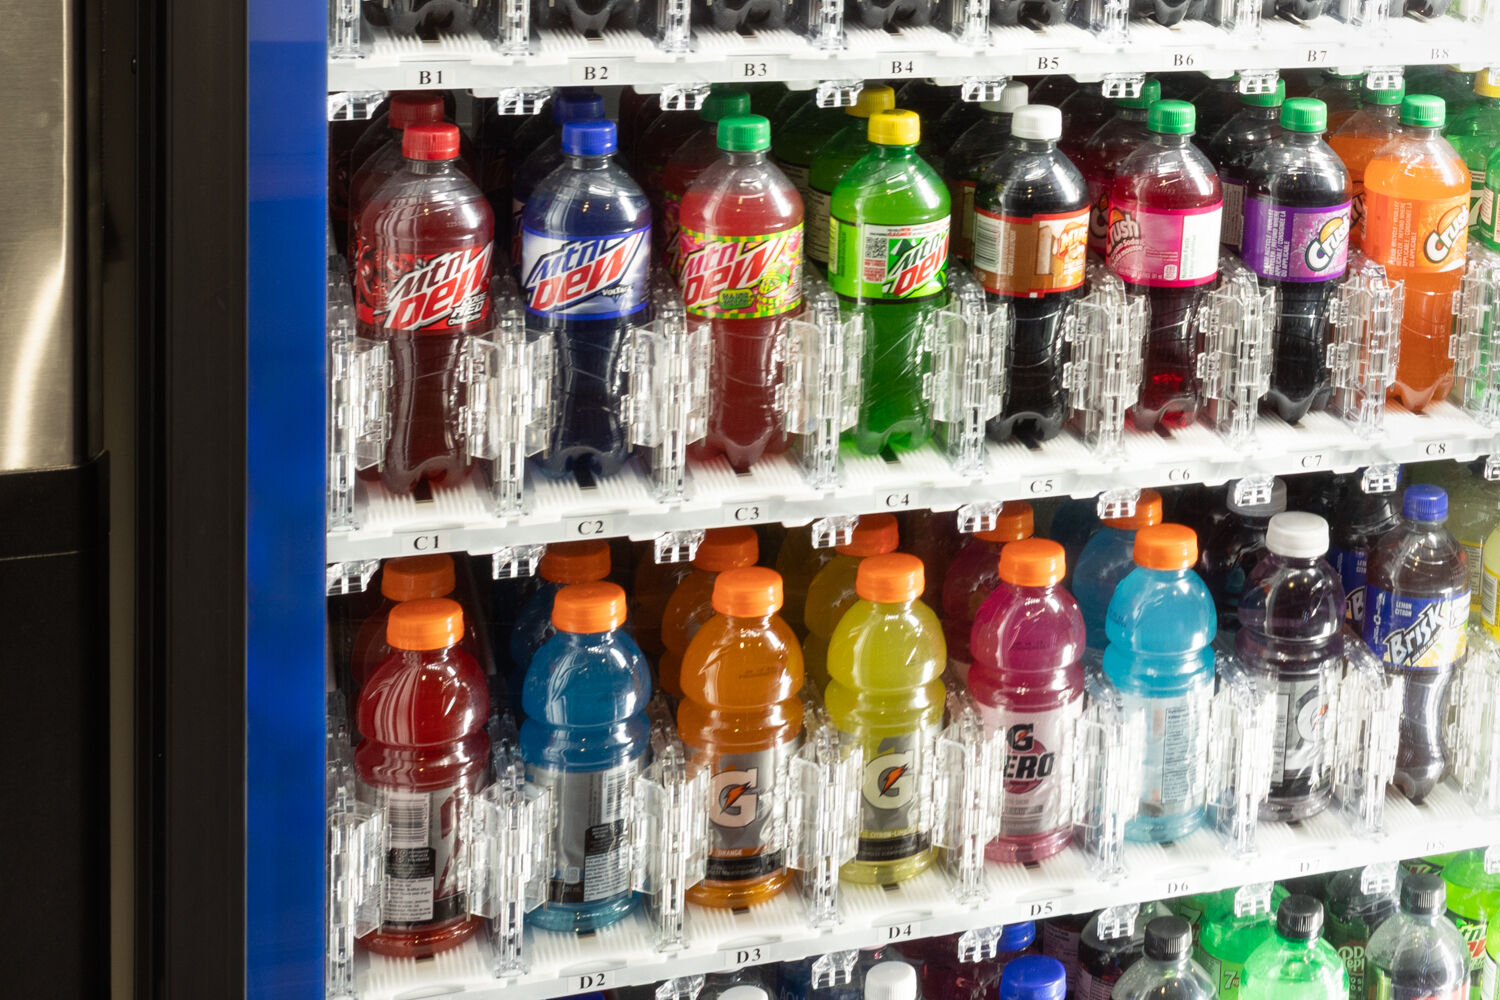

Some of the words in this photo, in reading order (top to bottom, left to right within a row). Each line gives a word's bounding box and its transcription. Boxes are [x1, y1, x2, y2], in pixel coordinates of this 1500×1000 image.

[1395, 608, 1412, 617] CITRON
[1396, 601, 1412, 609] LEMON
[1382, 600, 1443, 665] Brisk
[1006, 723, 1035, 752] G
[709, 766, 758, 828] G
[862, 752, 914, 810] G
